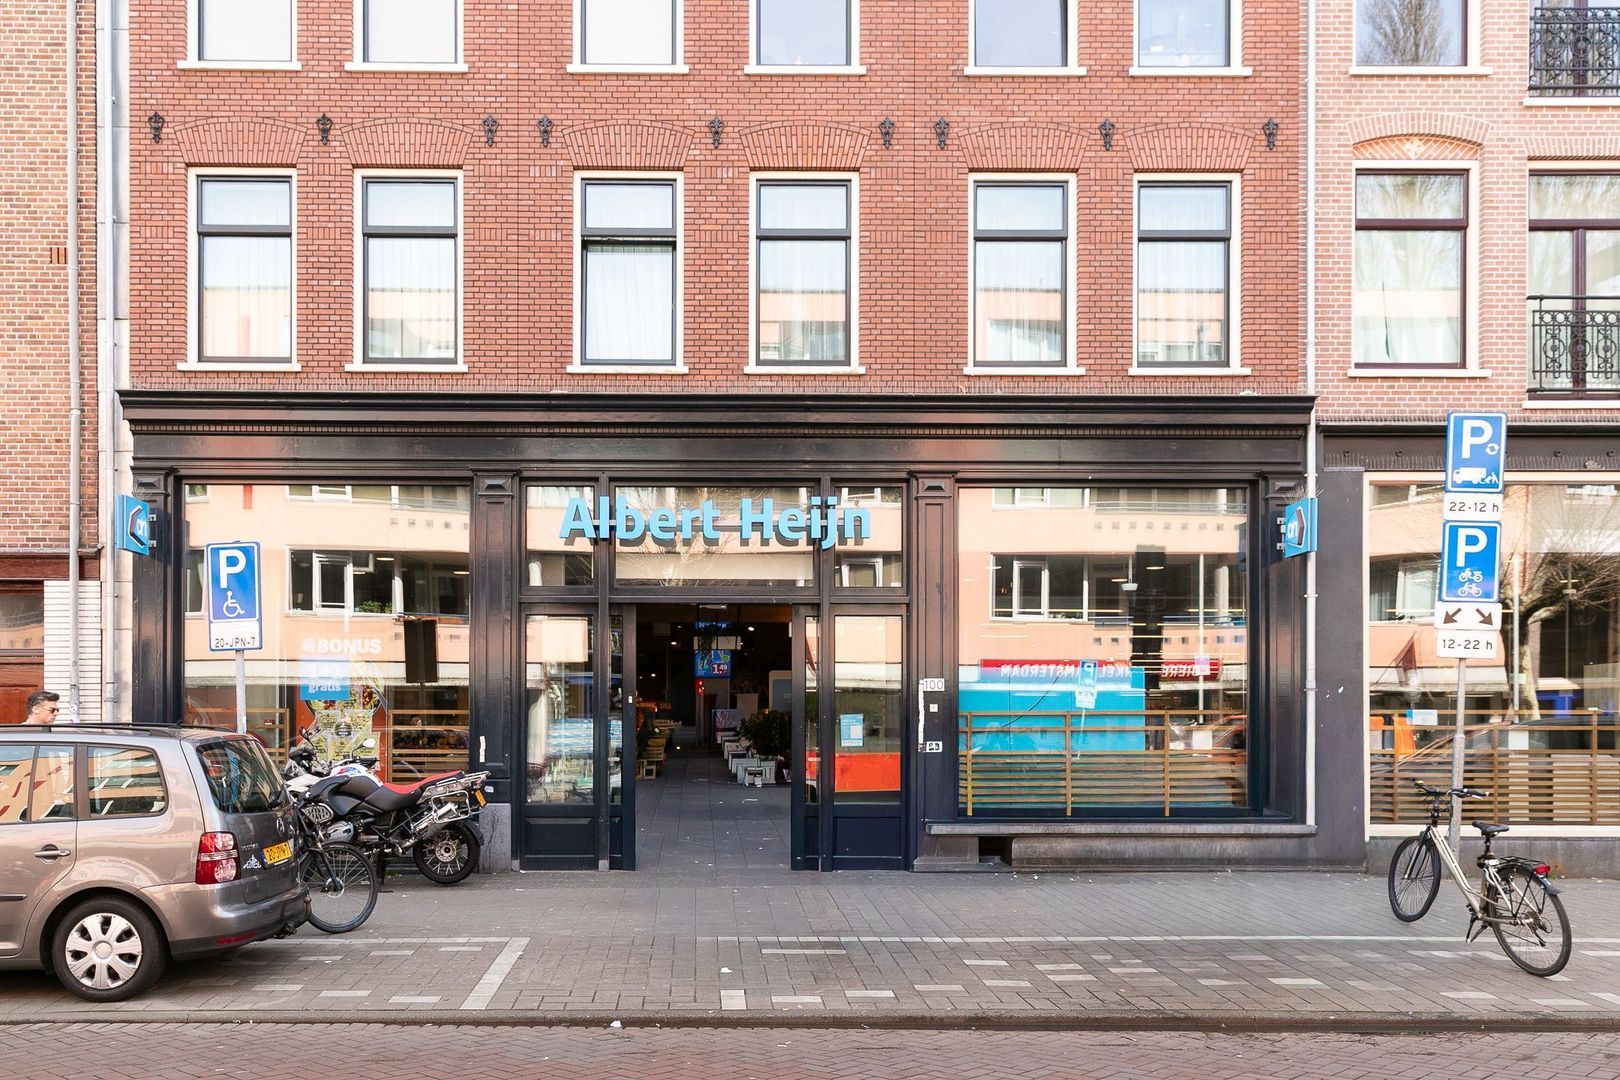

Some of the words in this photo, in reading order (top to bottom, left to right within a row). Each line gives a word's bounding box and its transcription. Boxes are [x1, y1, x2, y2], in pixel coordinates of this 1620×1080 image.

[1461, 419, 1493, 459] P
[1449, 501, 1487, 512] 22-12
[1492, 502, 1499, 512] h
[559, 496, 721, 540] Albert
[740, 496, 872, 549] Heijn
[1456, 527, 1488, 568] P
[219, 549, 247, 589] P
[214, 637, 256, 648] 20-JPN-7
[319, 639, 382, 654] BONUS
[1442, 639, 1481, 650] 12-22
[1485, 640, 1493, 650] h
[308, 681, 342, 693] gratis
[925, 679, 944, 690] 100
